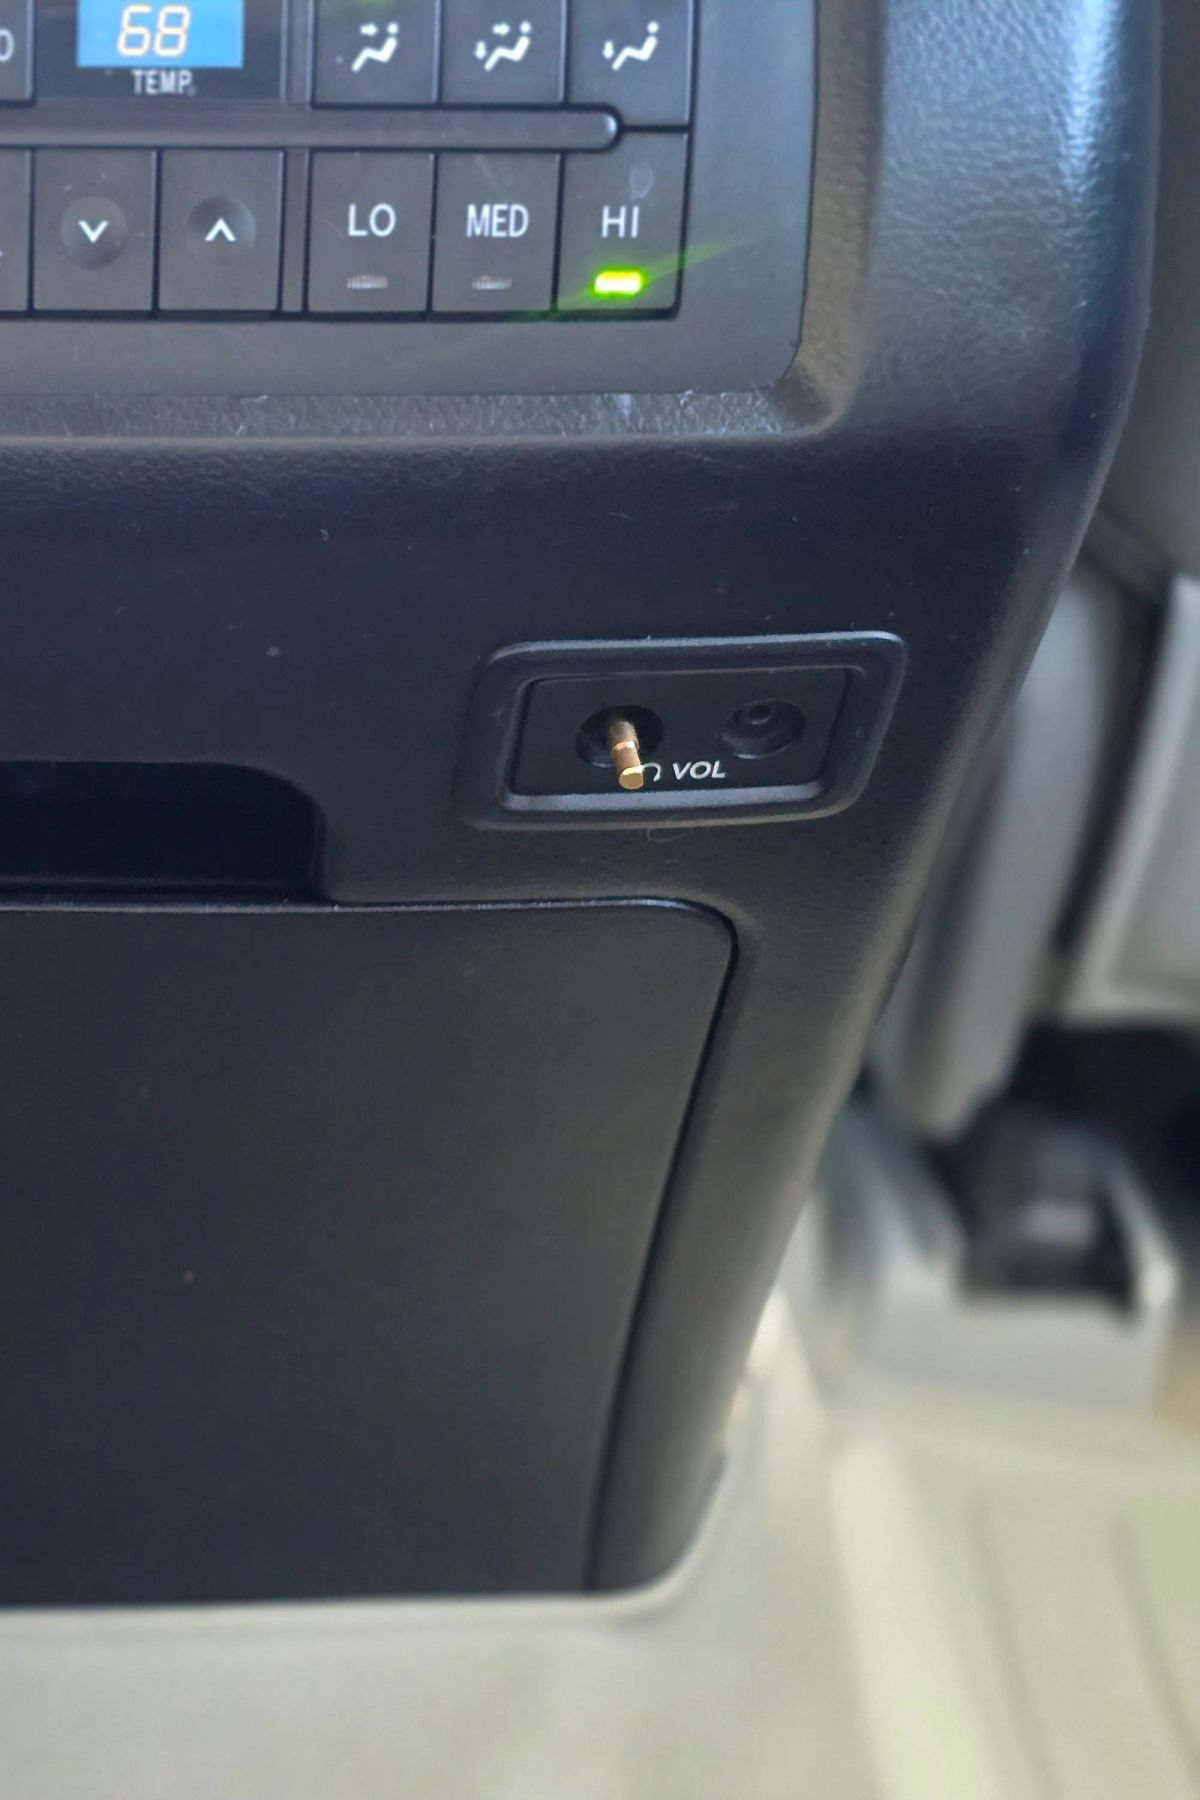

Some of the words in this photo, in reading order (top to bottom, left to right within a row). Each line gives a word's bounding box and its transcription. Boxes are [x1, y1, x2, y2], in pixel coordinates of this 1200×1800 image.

[117, 5, 191, 57] 68
[347, 204, 397, 238] LO
[466, 204, 530, 239] MED
[601, 205, 641, 239] HI
[671, 760, 727, 781] VOL
